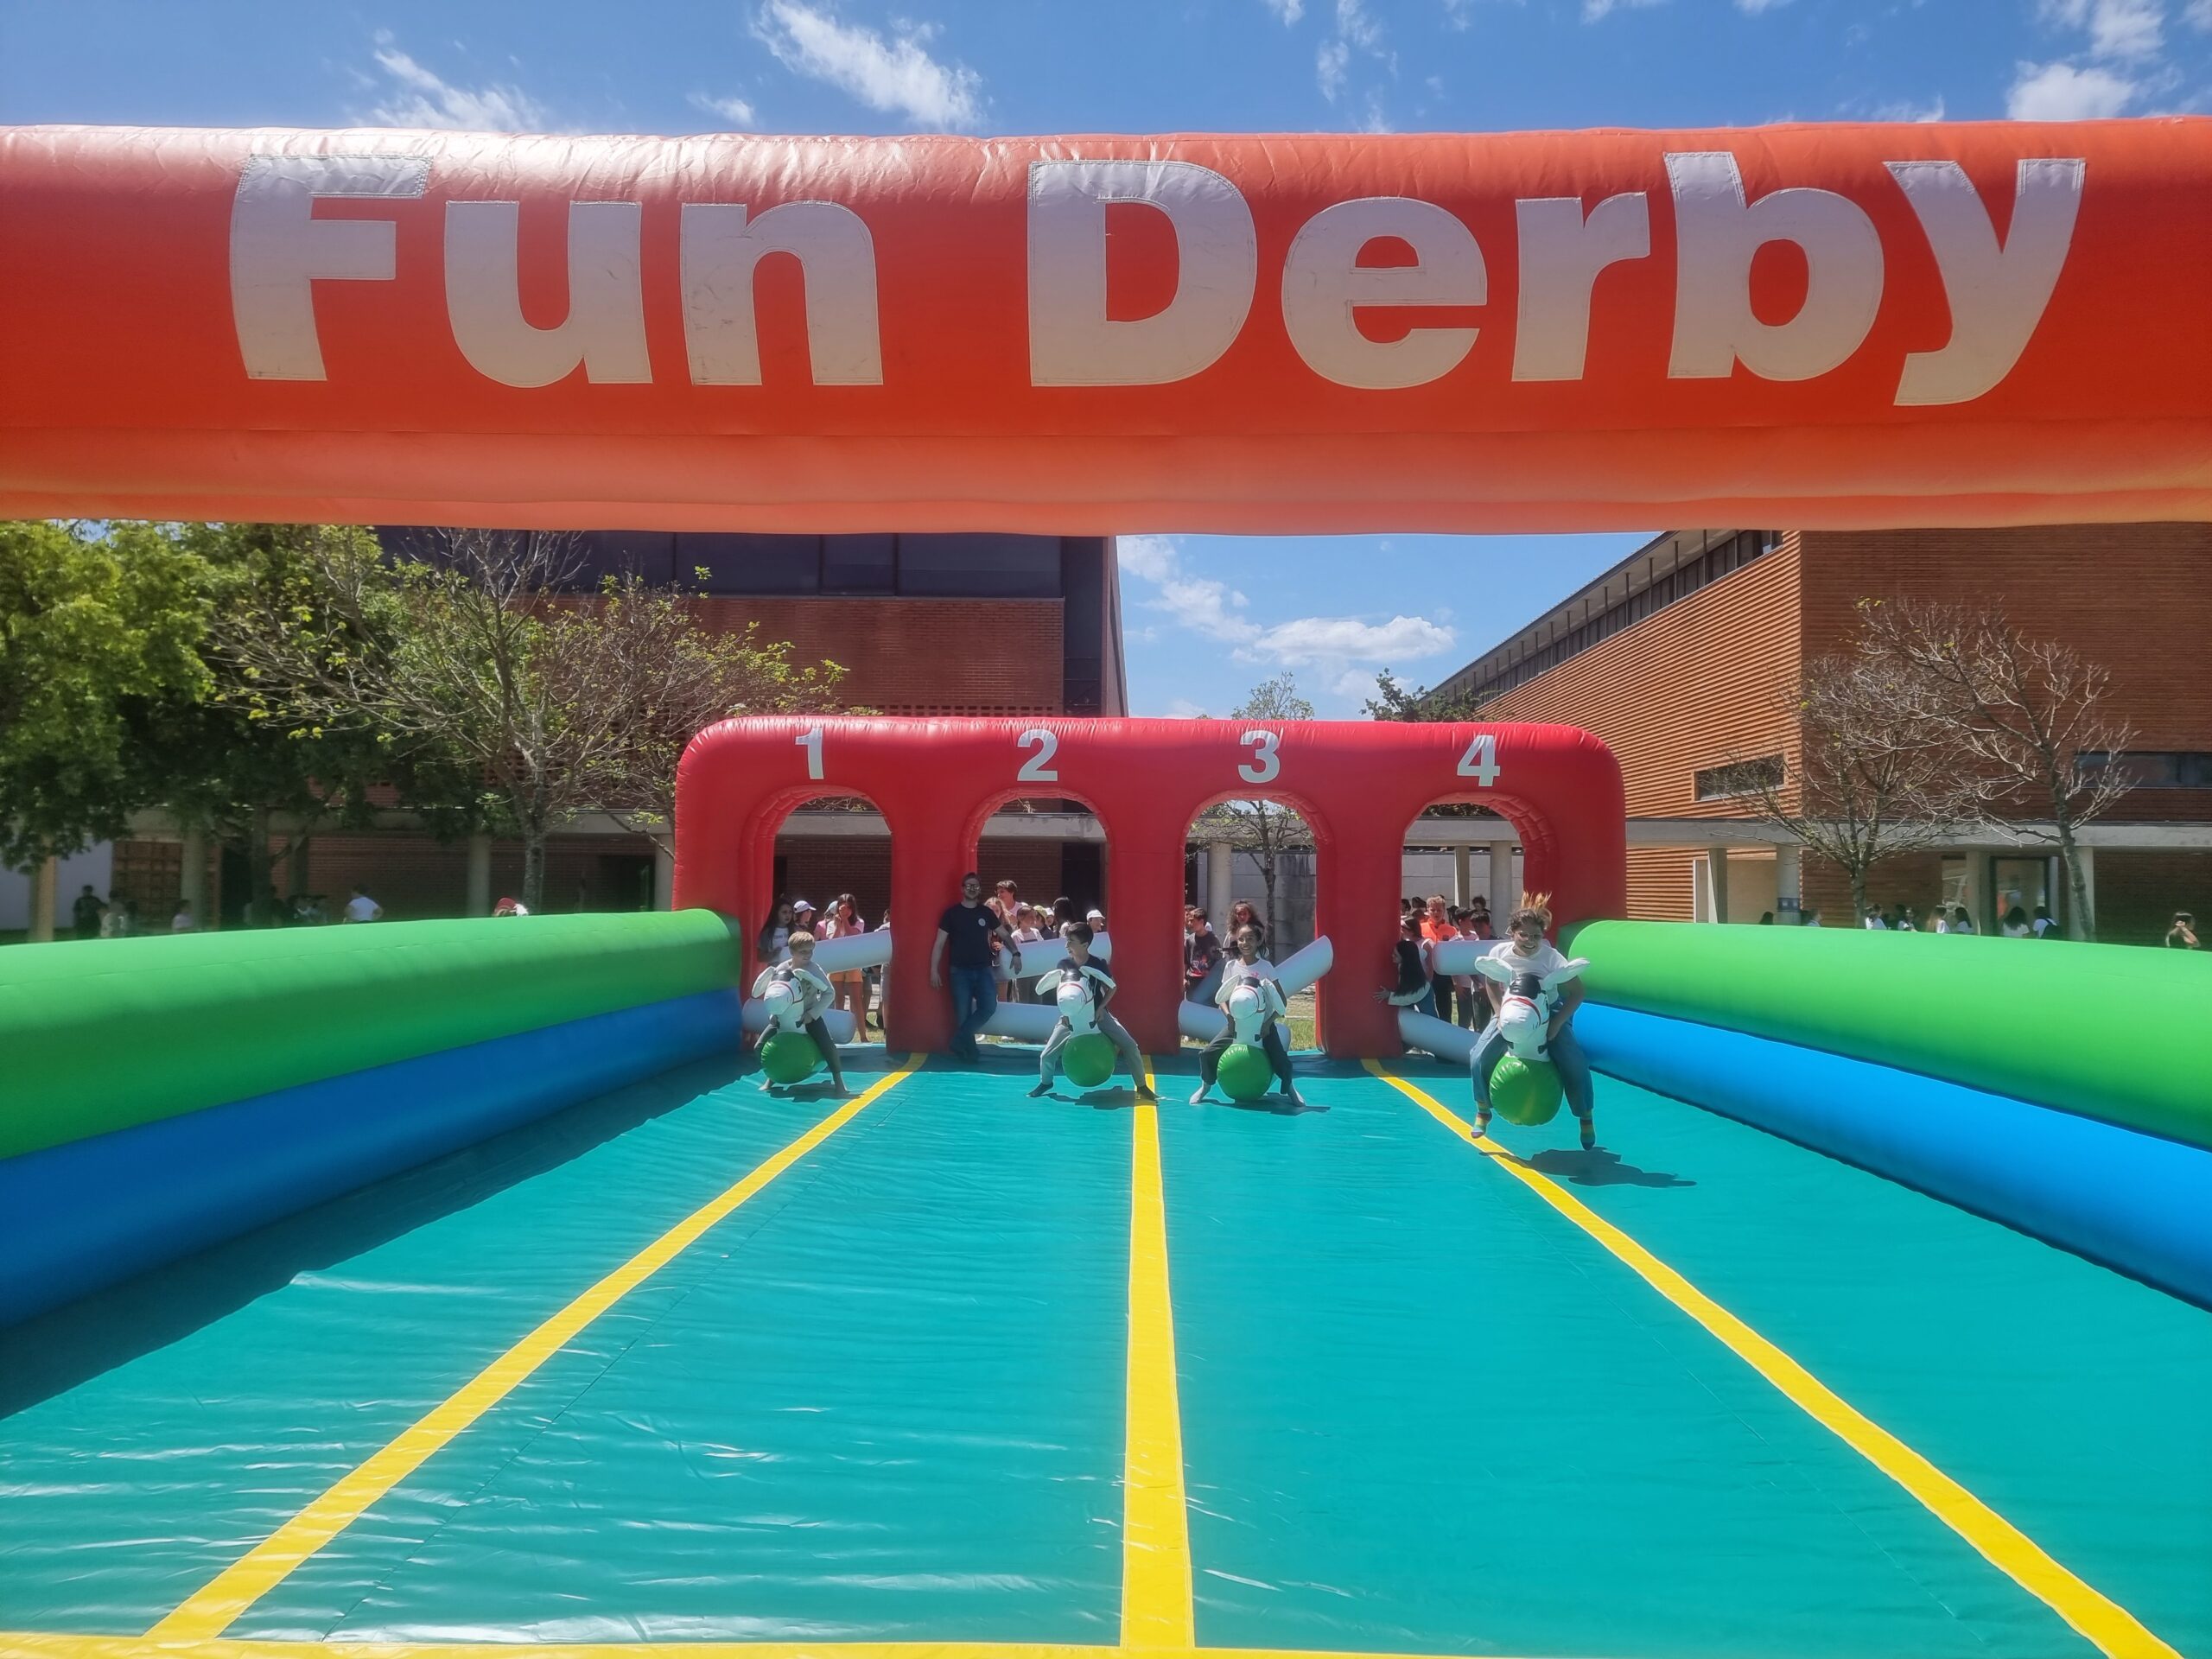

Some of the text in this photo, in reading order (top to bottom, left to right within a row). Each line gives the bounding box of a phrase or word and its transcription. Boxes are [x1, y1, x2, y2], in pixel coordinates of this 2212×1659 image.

[229, 150, 2087, 406] Fun Derby
[794, 727, 825, 780] 1
[1016, 728, 1058, 782] 2
[1237, 730, 1281, 784] 3
[1457, 734, 1501, 787] 4
